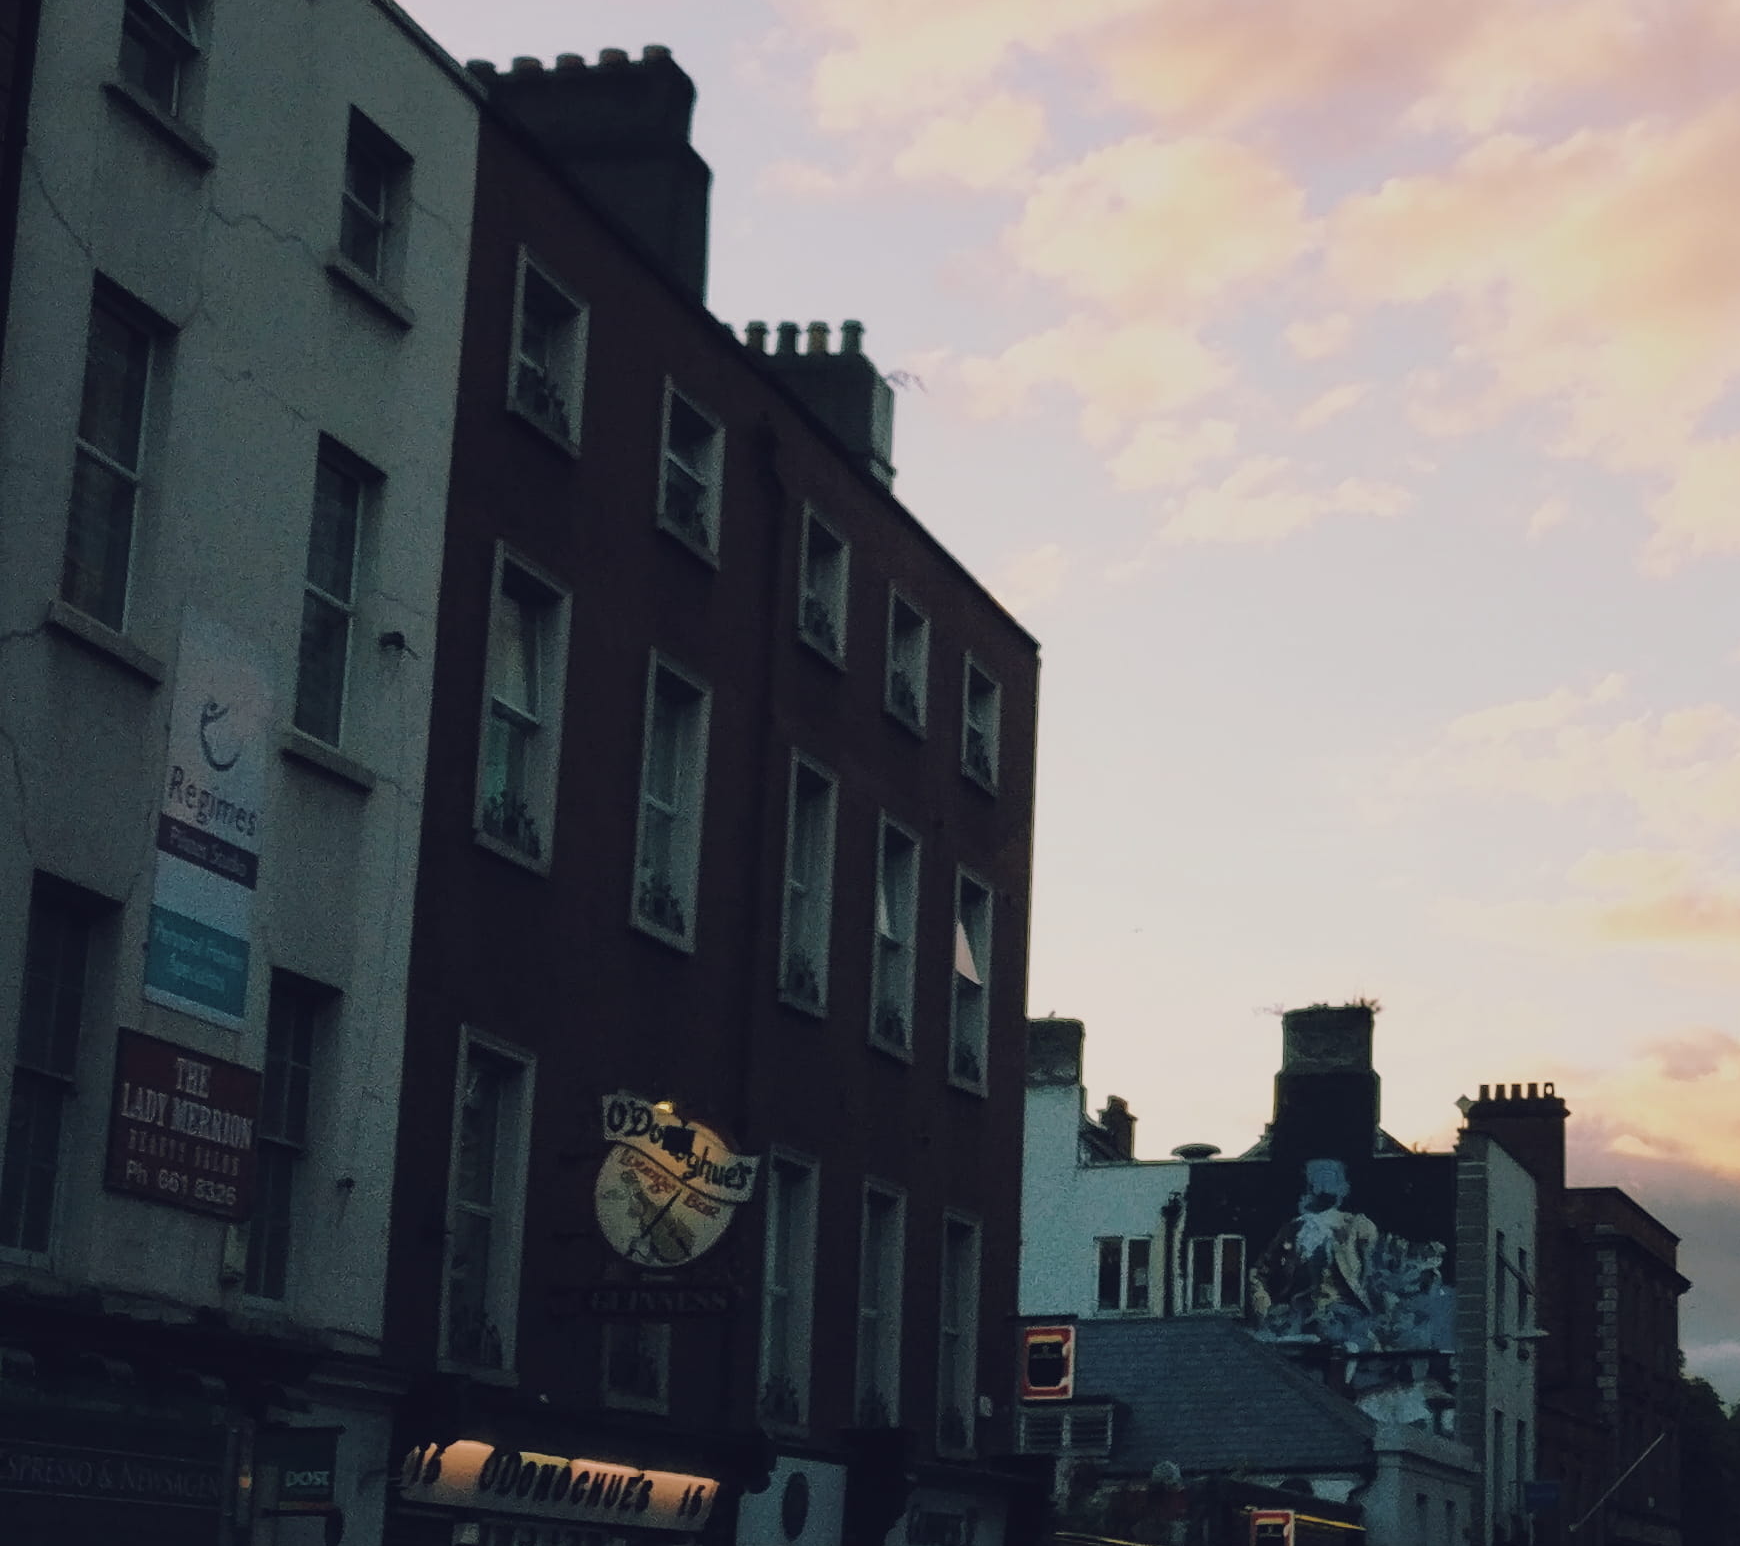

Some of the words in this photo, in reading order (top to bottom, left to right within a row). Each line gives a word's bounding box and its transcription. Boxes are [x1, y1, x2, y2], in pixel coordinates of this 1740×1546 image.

[168, 765, 257, 837] Regimes
[176, 1057, 212, 1099] THE
[121, 1082, 169, 1128] LADY
[169, 1096, 255, 1150] MERRION
